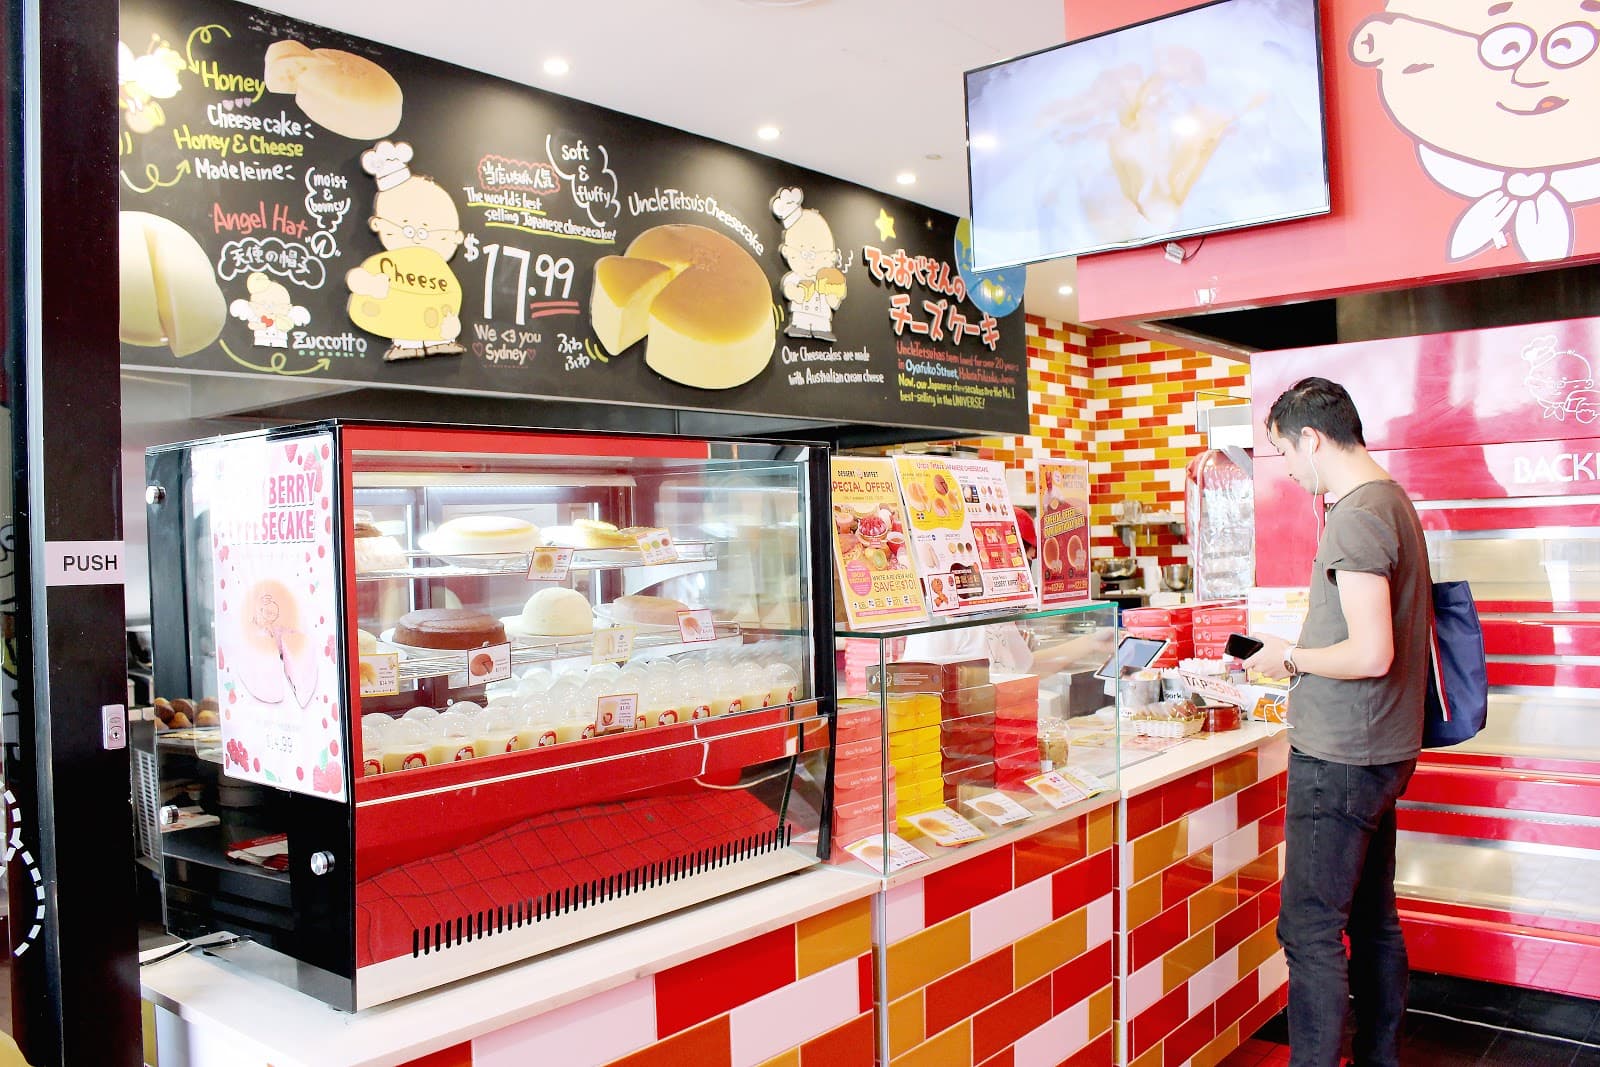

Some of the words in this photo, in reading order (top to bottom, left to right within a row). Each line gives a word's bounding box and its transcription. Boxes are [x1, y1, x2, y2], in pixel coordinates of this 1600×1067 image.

[202, 61, 265, 103] Honey
[173, 125, 231, 157] Honey
[232, 134, 249, 154] &
[249, 135, 304, 157] Cheese
[195, 157, 285, 181] Madeleine
[313, 173, 348, 189] moist
[578, 165, 590, 182] &
[309, 198, 345, 213] bouncy
[463, 186, 483, 203] The
[484, 190, 522, 207] world's
[523, 193, 542, 210] best
[577, 185, 611, 208] fluffy
[213, 200, 267, 234] Angel
[272, 203, 308, 239] Hat
[484, 208, 519, 225] selling
[520, 212, 563, 233] Japanese
[628, 187, 669, 216] Uncle
[705, 196, 764, 257] Cheesecake
[230, 246, 311, 274] 天使の帽子
[380, 257, 448, 293] Cheese
[463, 233, 575, 326] $17.99
[889, 293, 1000, 350] チーズケーキ
[292, 331, 367, 353] Zuccotto
[474, 324, 497, 341] We
[519, 332, 542, 348] you
[485, 344, 527, 365] Sydney
[781, 345, 799, 365] Our
[799, 346, 842, 361] Cheesecakes
[842, 351, 854, 361] are
[788, 370, 805, 386] with
[805, 367, 844, 385] Australian
[863, 369, 885, 383] cheese
[1513, 452, 1600, 484] BACK
[831, 480, 864, 493] PECIAL
[63, 554, 119, 572] PUSH
